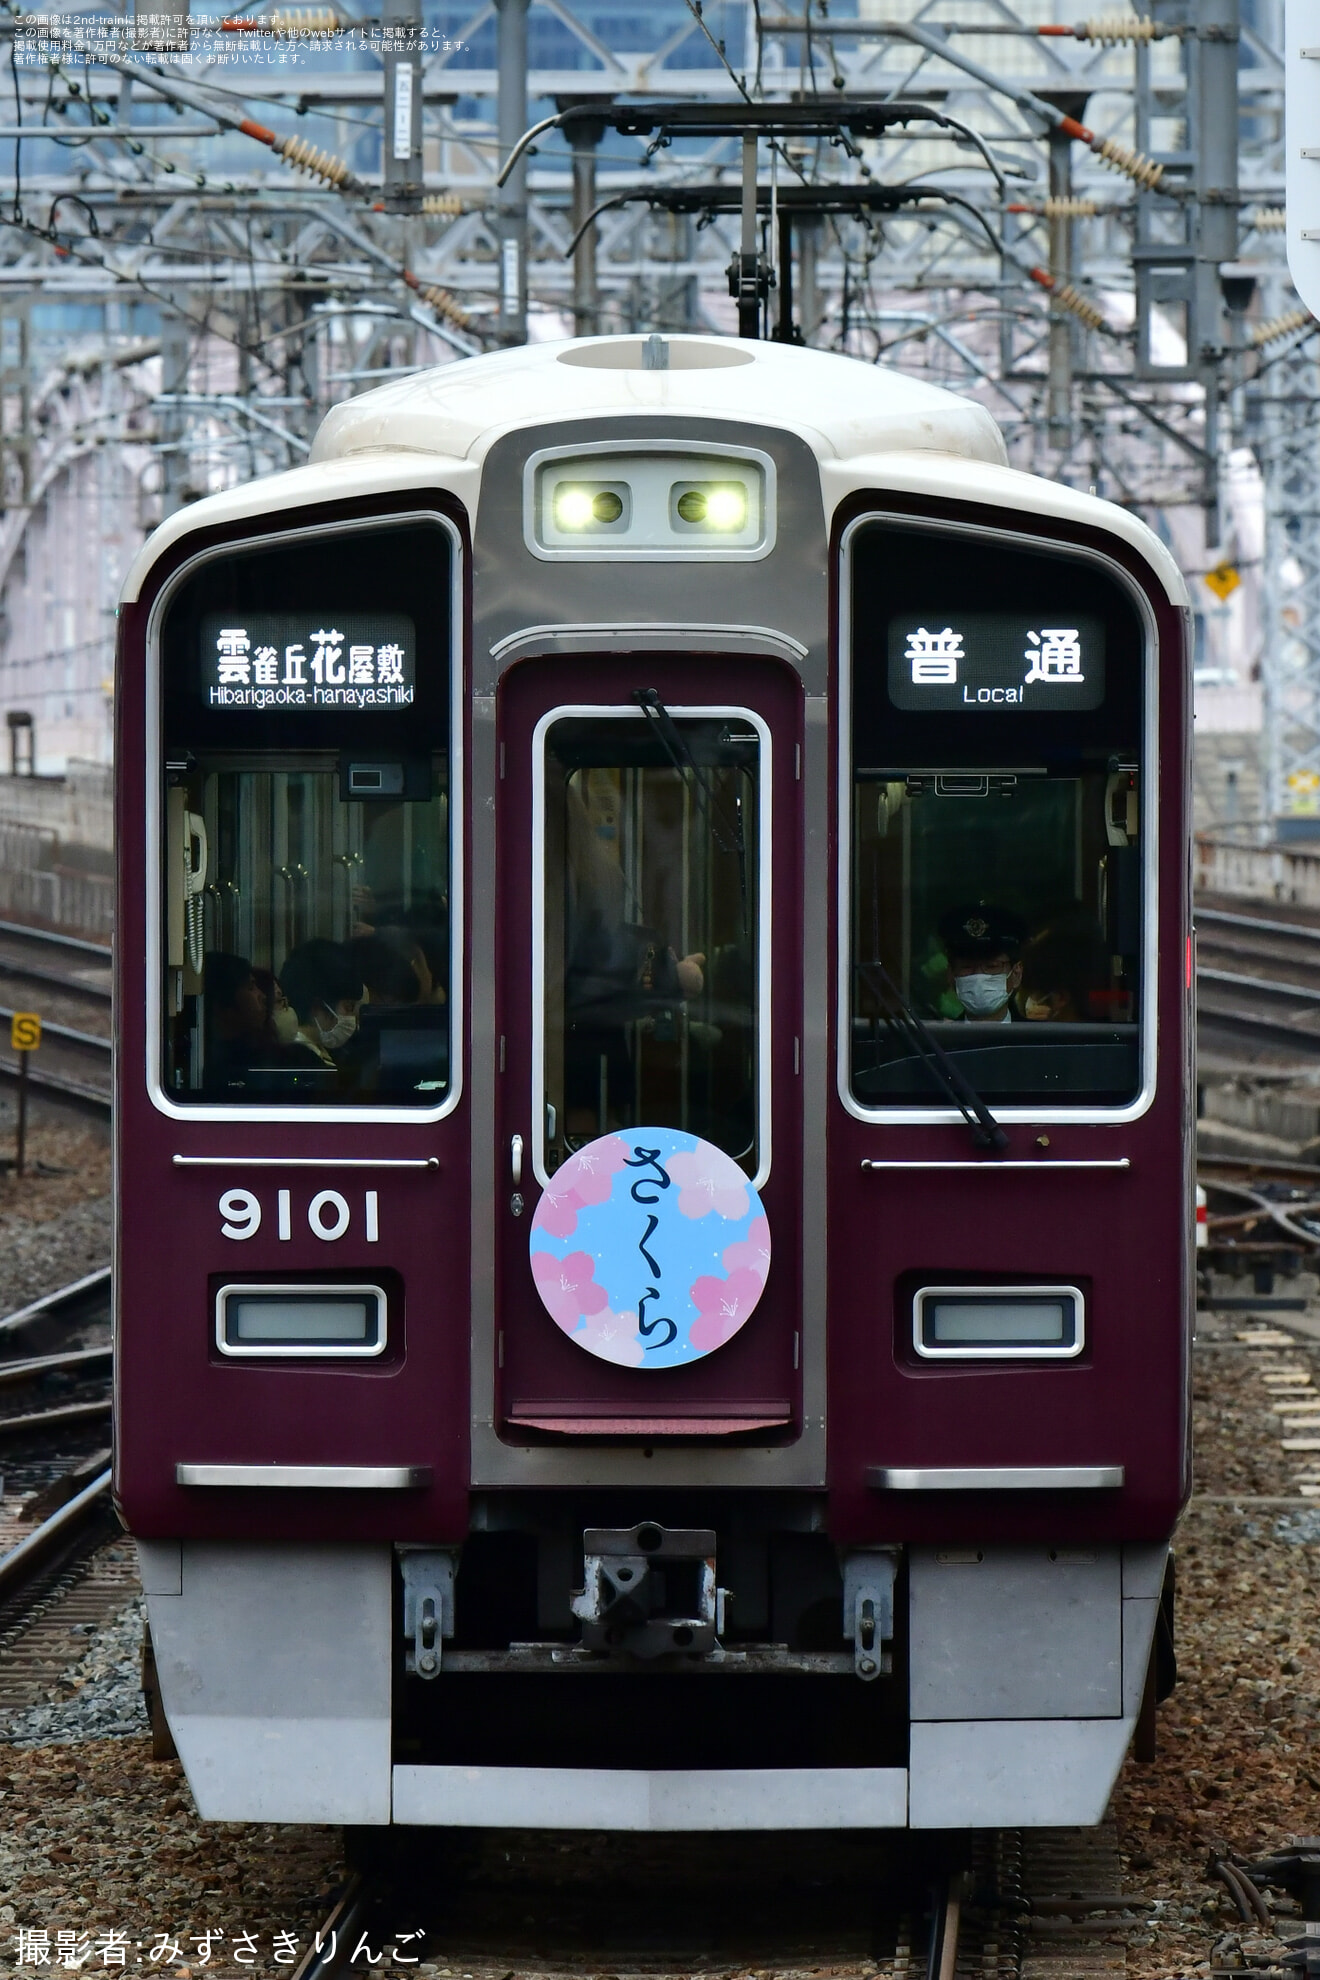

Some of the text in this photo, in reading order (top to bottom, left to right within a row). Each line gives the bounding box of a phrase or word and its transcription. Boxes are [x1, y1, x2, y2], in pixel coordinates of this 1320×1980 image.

[216, 628, 405, 684] 雲雀丘花屋敷
[210, 685, 414, 708] Hibarigaoka-hanayashiki
[963, 685, 1024, 703] Local
[17, 1018, 36, 1045] S
[218, 1188, 379, 1242] 9101
[623, 1146, 678, 1350] さくら
